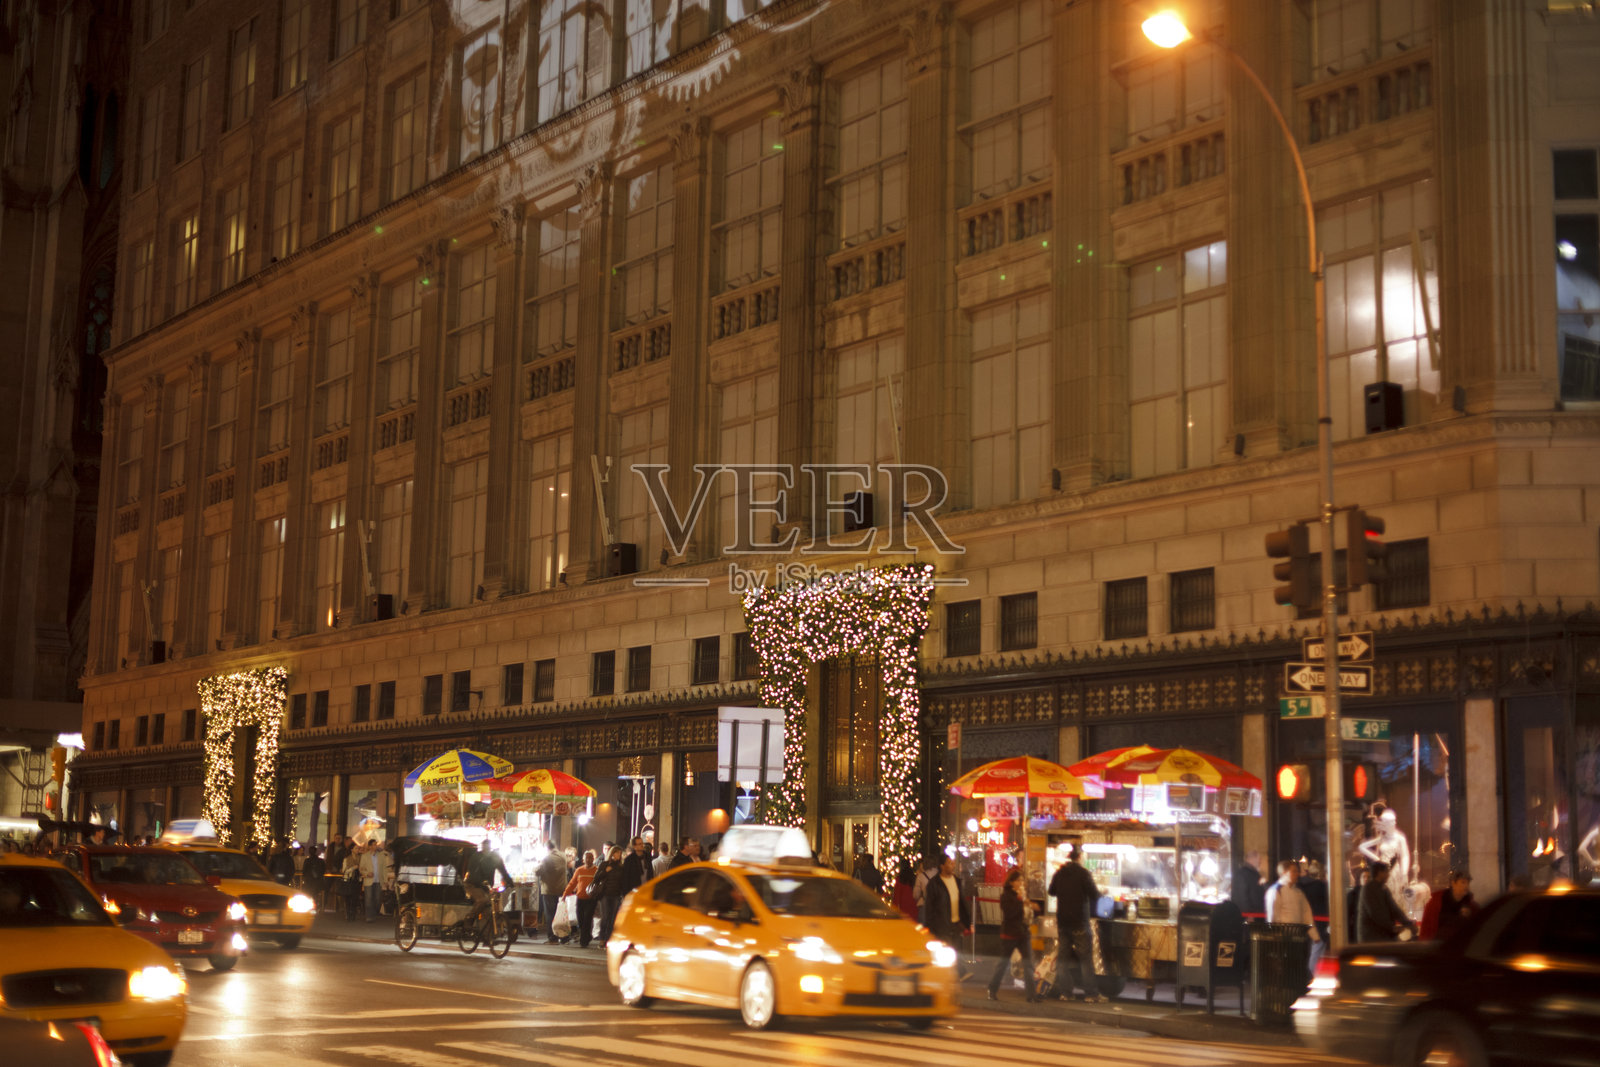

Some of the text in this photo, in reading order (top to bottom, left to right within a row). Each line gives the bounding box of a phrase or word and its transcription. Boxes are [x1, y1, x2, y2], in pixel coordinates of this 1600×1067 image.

[1341, 642, 1362, 653] WAY
[1299, 672, 1324, 684] ONE
[1287, 699, 1298, 716] 5
[1362, 721, 1380, 738] 49
[420, 775, 461, 786] SABRETT
